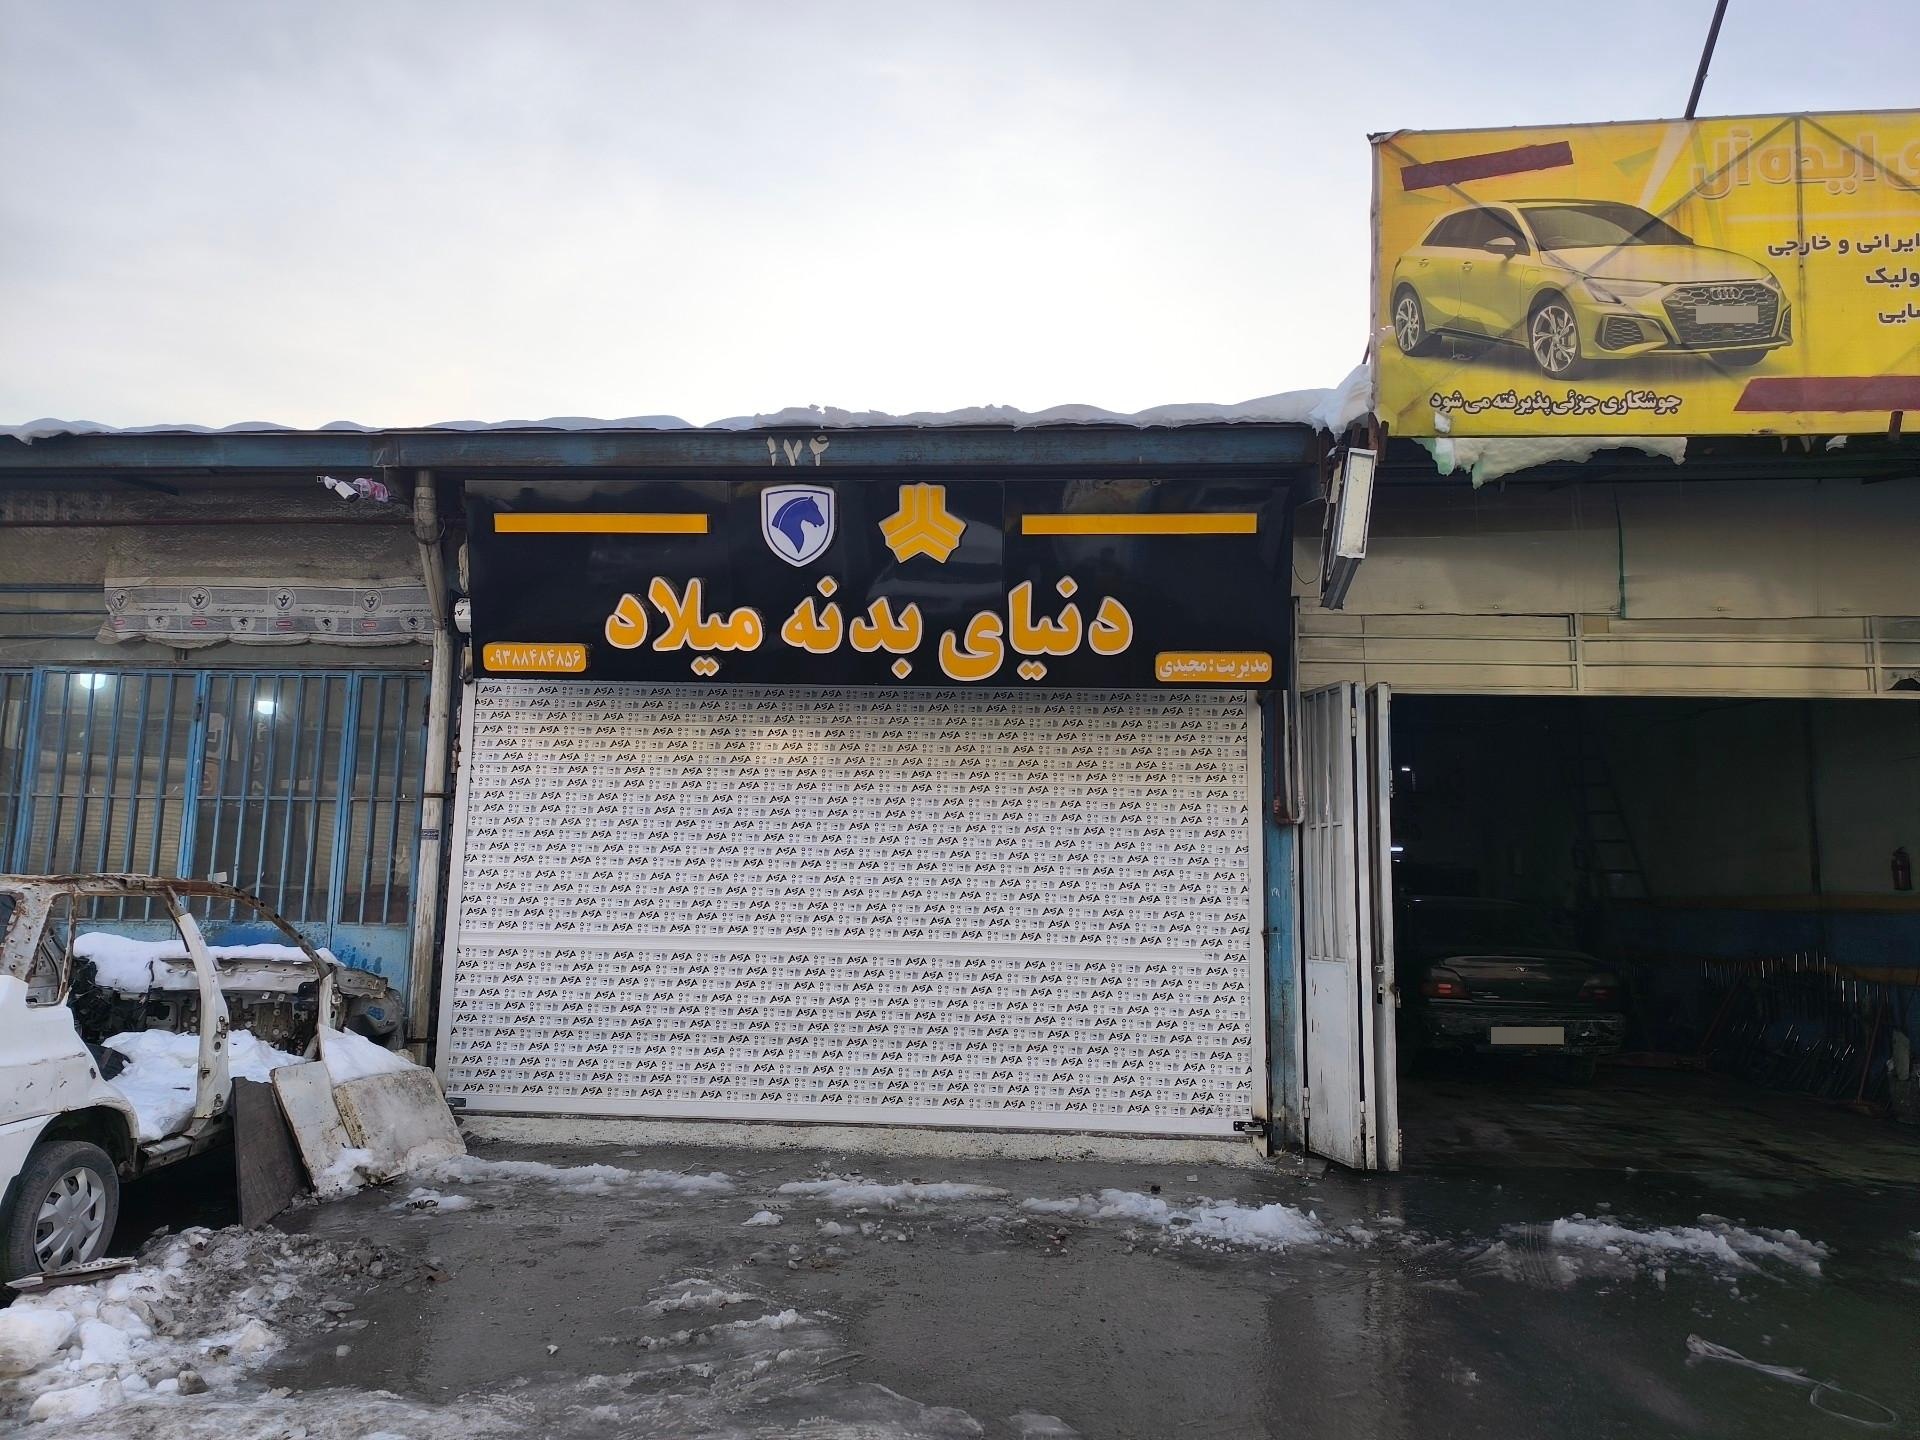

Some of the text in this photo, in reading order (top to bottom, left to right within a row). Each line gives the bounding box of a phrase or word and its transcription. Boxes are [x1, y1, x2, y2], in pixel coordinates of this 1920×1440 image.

[1767, 232, 1920, 257] ایرانی و خارجی
[1491, 388, 1552, 417] پذیرفته
[1599, 389, 1683, 416] جوشکاری
[604, 575, 1134, 682] دنیای بدنه میلاد
[481, 684, 1191, 702] ASA ASA ASA ASA ASA ASA ASA ASA ASA ASA ASA ASA ASA
[482, 724, 1196, 743] ASA ASA ASA ASA ASA ASA ASA ASA ASA ASA ASA ASA ASA
[511, 764, 1227, 783] ASA ASA ASA ASA ASA ASA ASA ASA ASA ASA ASA ASA ASA
[503, 816, 1225, 838] ASA ASA ASA ASA ASA ASA ASA ASA ASA ASA ASA ASA ASA
[513, 854, 1235, 881] ASA ASA ASA ASA ASA ASA ASA ASA ASA ASA ASA ASA ASA
[496, 881, 1221, 905] ASA ASA ASA ASA ASA ASA ASA ASA ASA ASA ASA ASA ASA
[498, 948, 1228, 976] ASA ASA ASA ASA ASA ASA ASA ASA ASA ASA ASA ASA ASA
[479, 987, 1210, 1017] ASA ASA ASA ASA ASA ASA ASA ASA ASA ASA ASA ASA ASA
[494, 1027, 1232, 1060] ASA ASA ASA ASA ASA ASA ASA ASA ASA ASA ASA ASA ASA
[463, 1082, 1214, 1116] ASA ASA ASA ASA ASA ASA ASA ASA ASA ASA ASA ASA ASA
